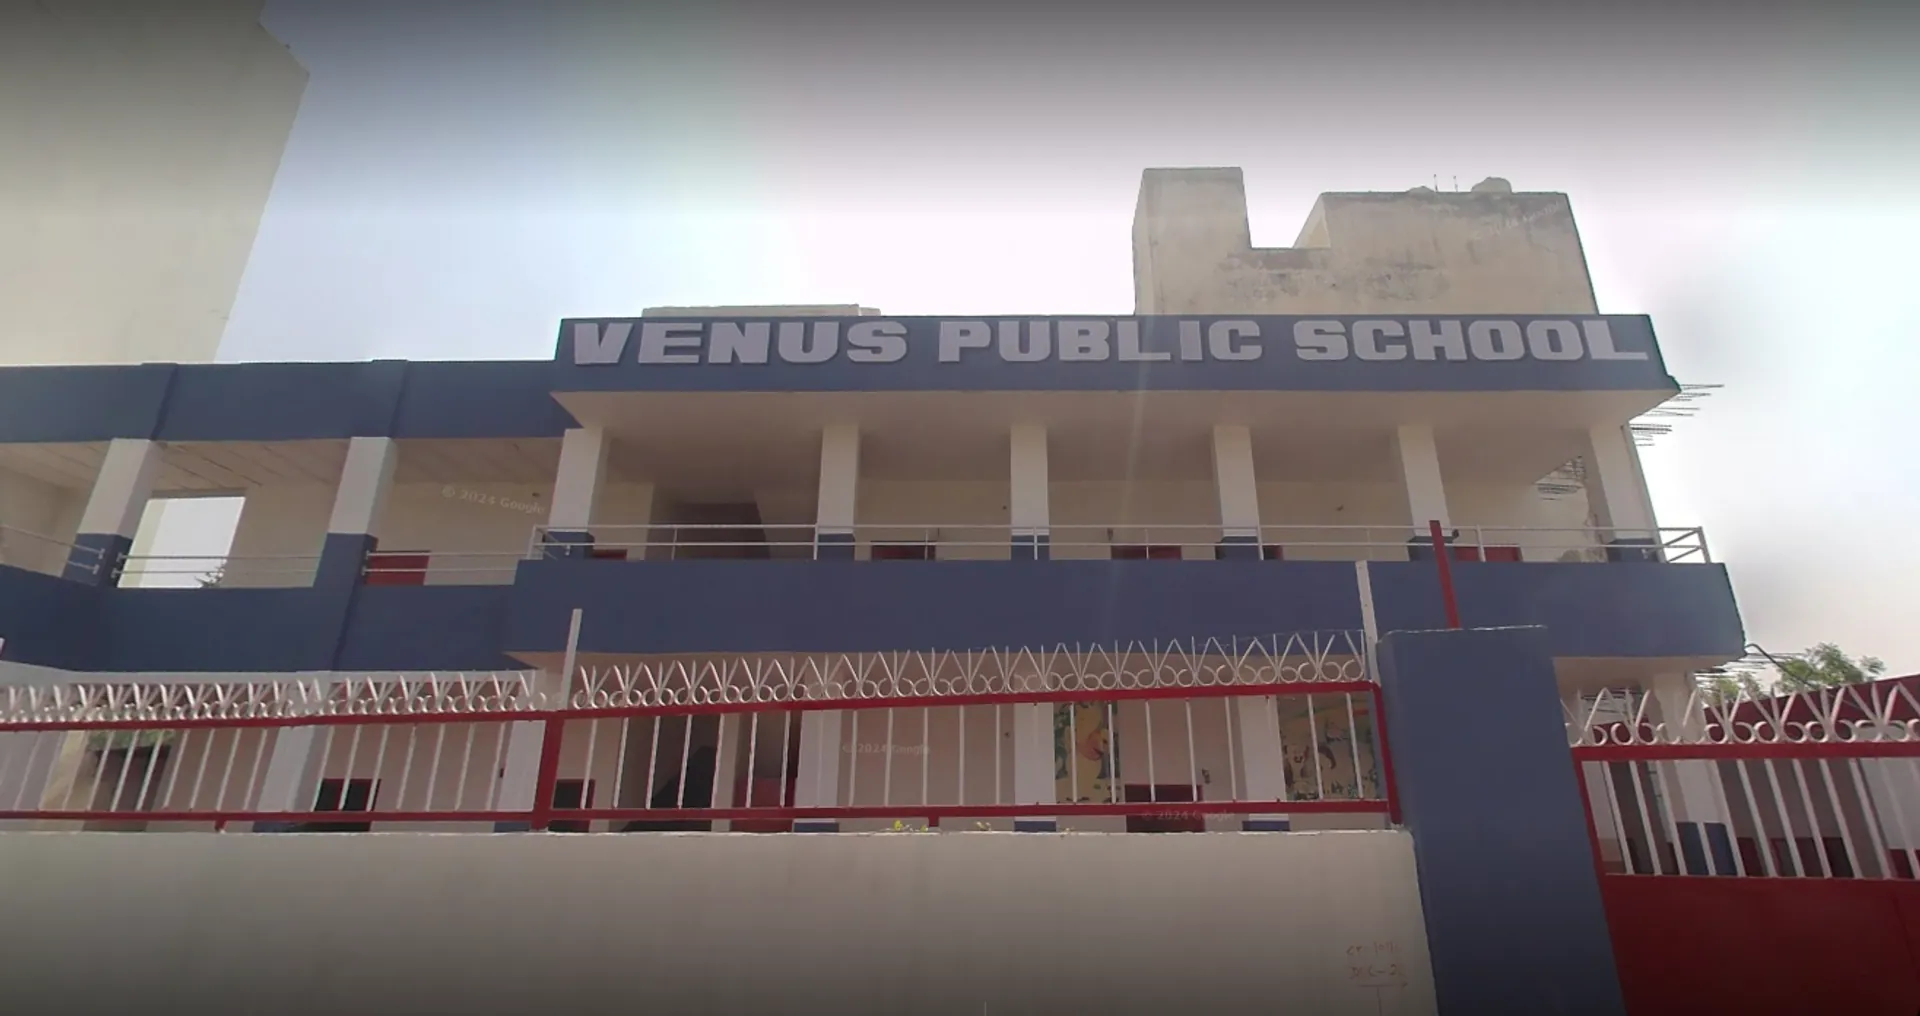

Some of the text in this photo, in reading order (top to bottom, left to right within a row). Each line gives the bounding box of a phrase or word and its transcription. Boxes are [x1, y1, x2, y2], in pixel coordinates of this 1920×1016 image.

[574, 319, 1649, 365] VENUS PUBLIC SCHOOL
